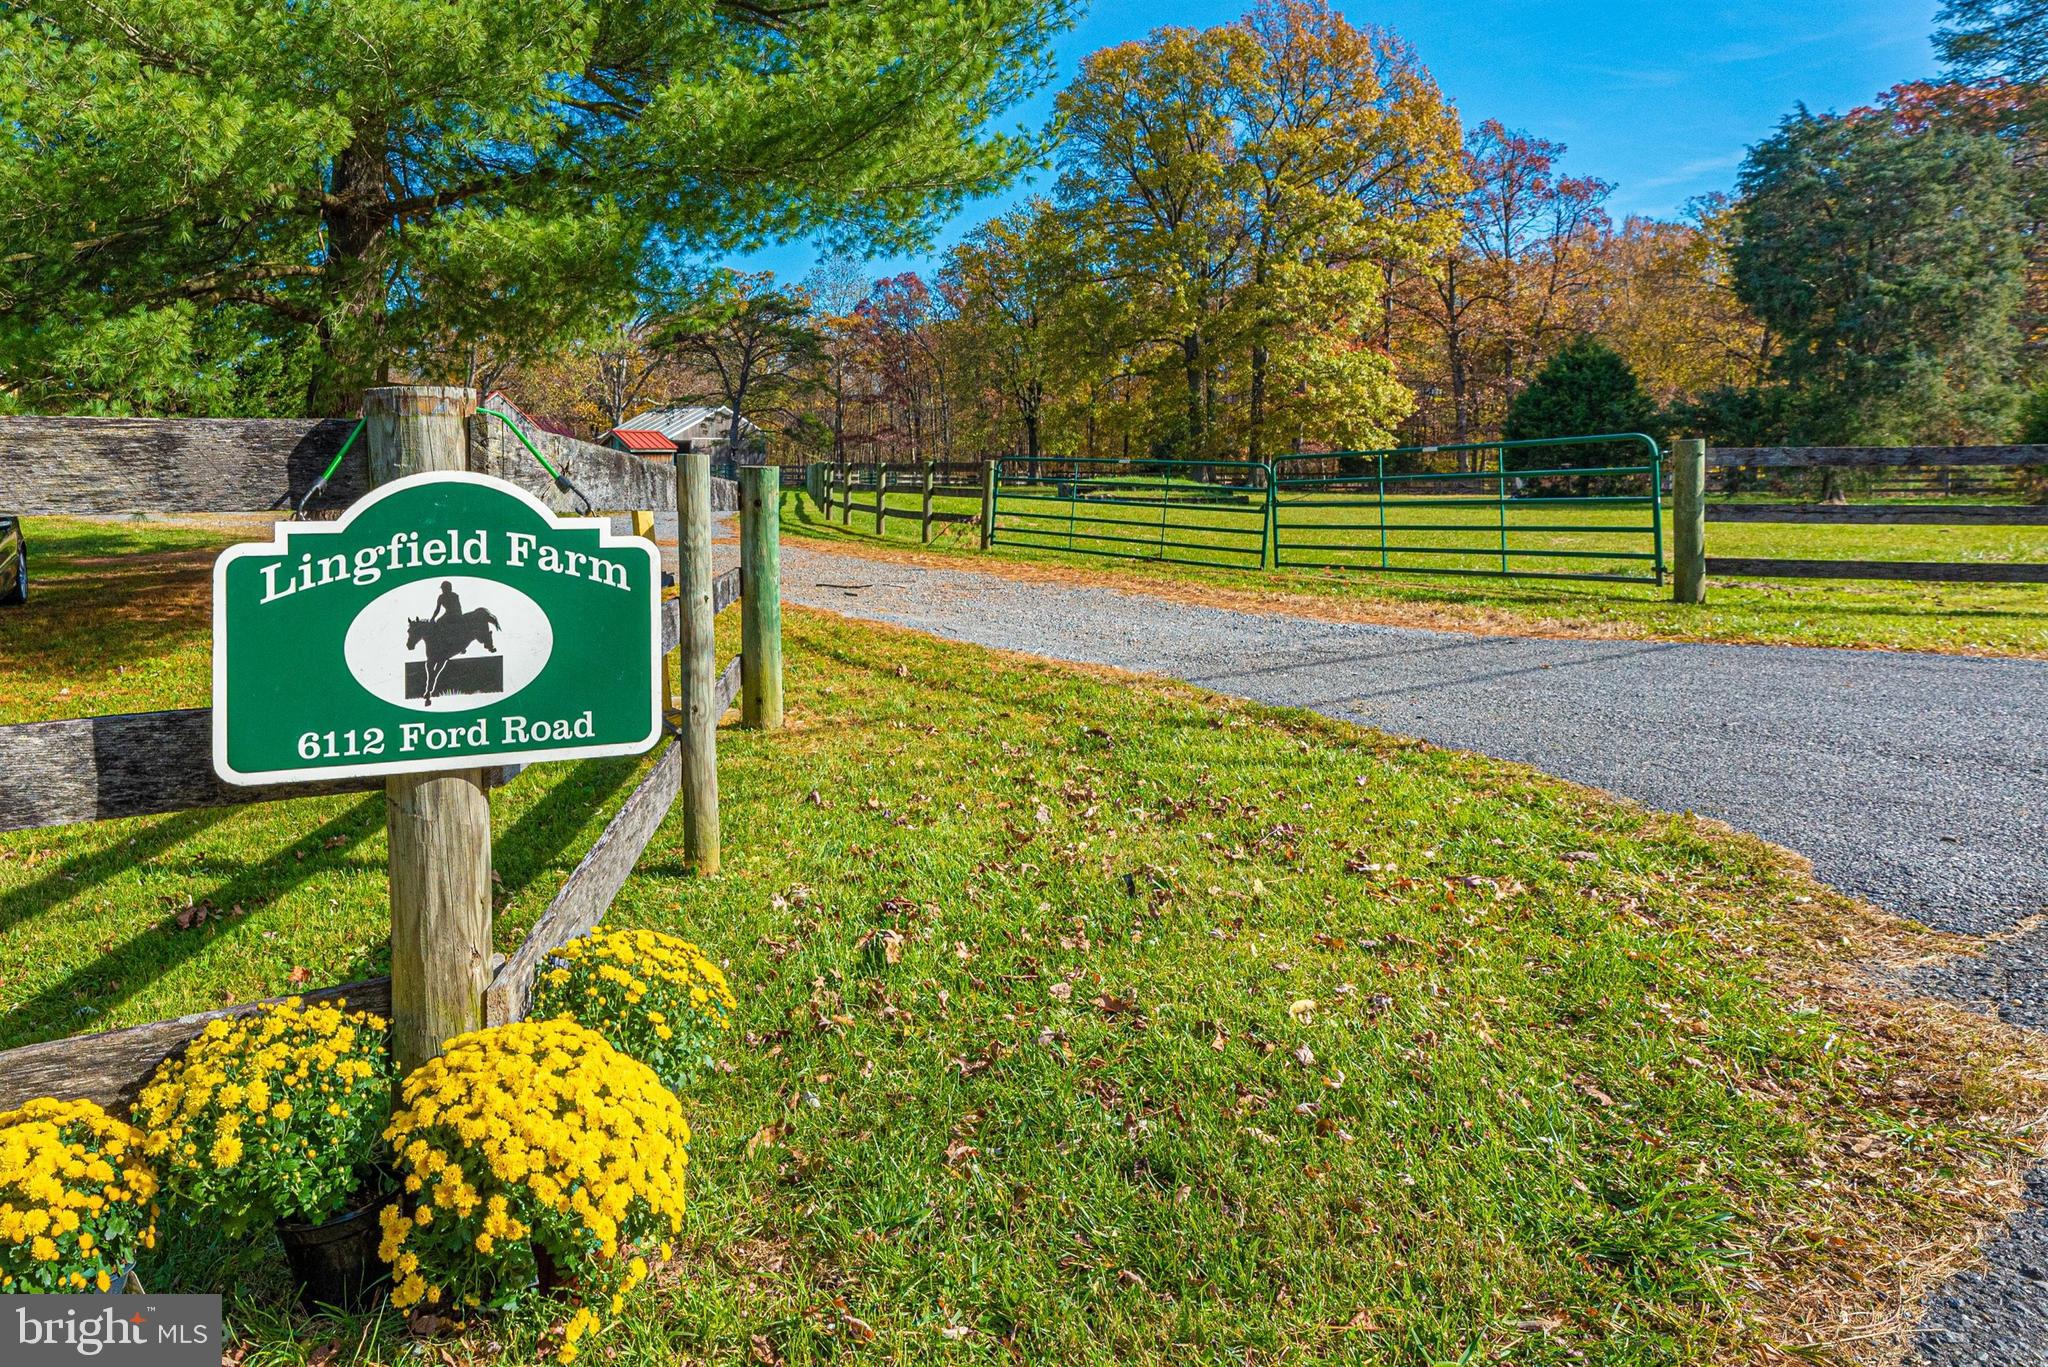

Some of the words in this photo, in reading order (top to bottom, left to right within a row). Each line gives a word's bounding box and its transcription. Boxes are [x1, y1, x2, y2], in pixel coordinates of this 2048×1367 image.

[260, 529, 491, 605] Lingfield
[506, 531, 631, 592] Farm
[297, 727, 385, 760] 6112
[399, 718, 490, 752] Ford
[501, 711, 595, 744] Road
